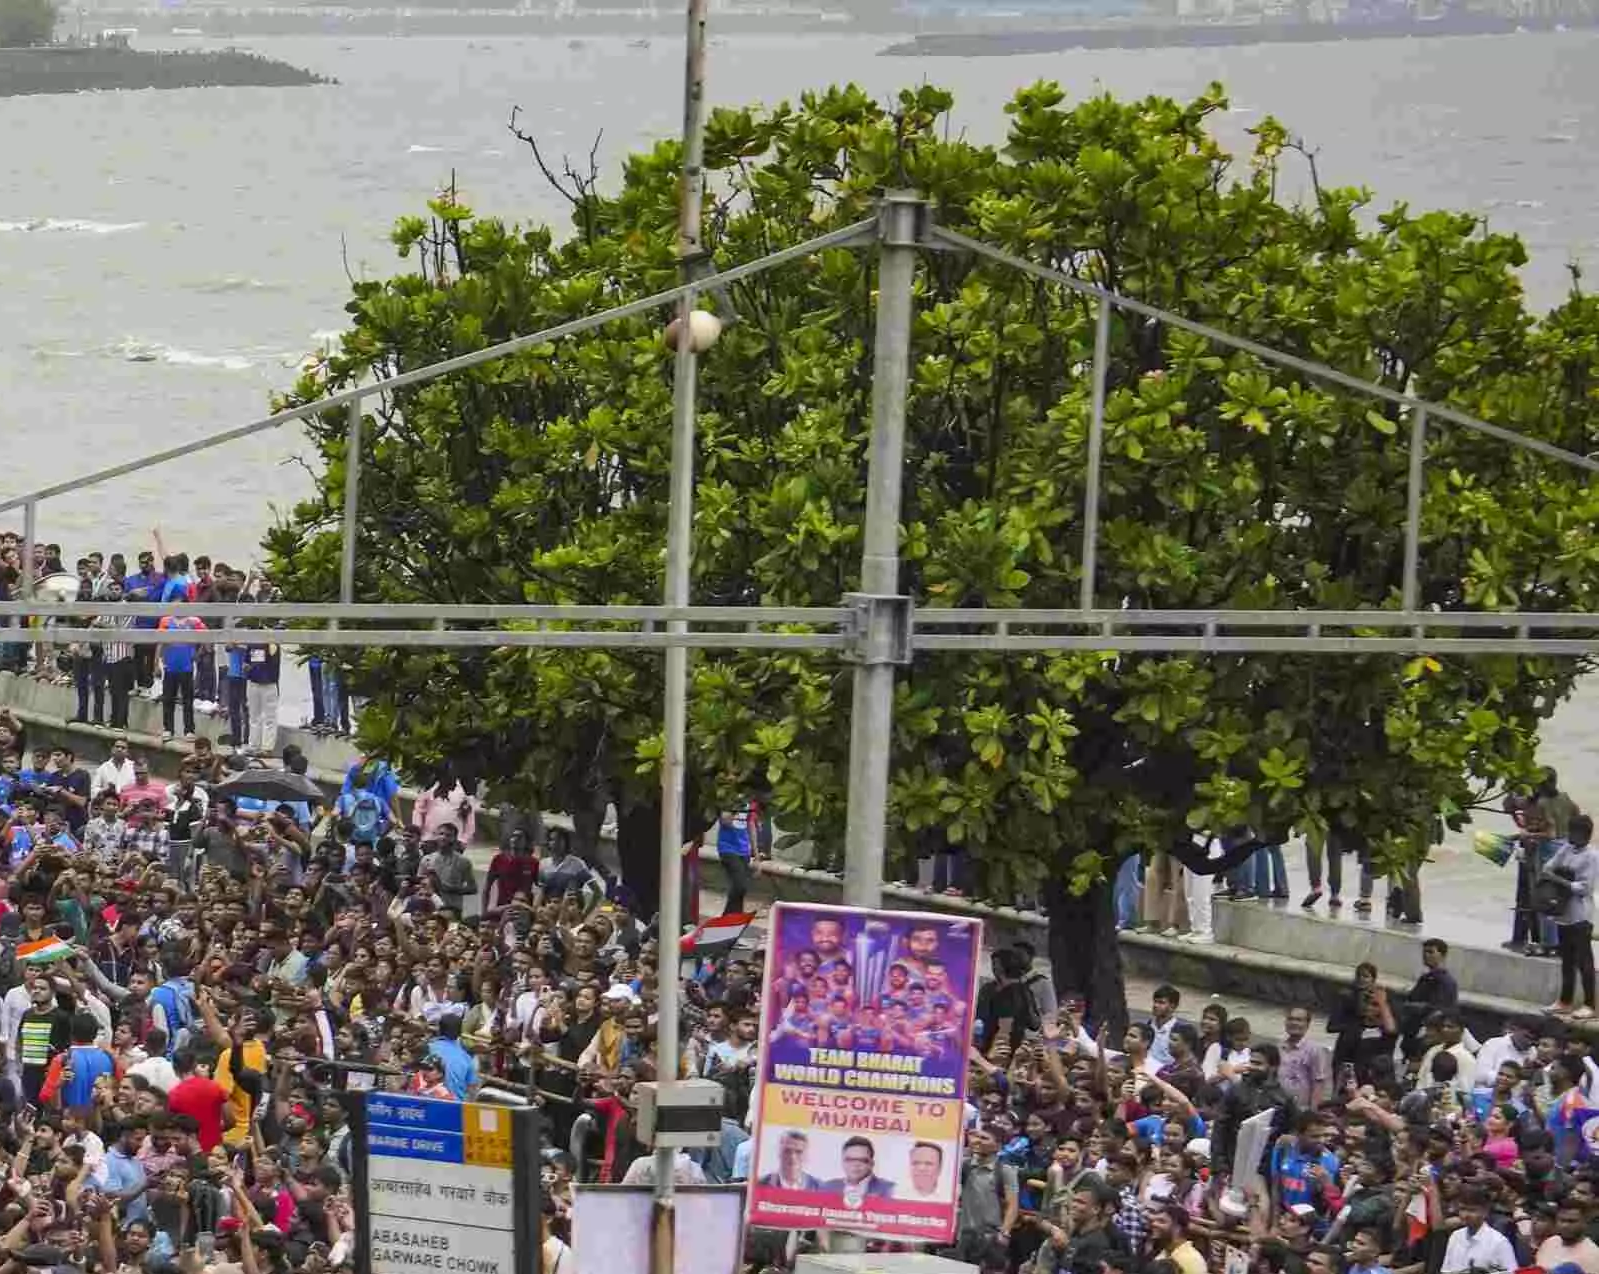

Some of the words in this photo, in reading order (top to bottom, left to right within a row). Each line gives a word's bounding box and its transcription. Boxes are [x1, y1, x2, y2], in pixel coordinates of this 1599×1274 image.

[808, 1047, 854, 1066] TEAM
[857, 1052, 924, 1074] BHARAT
[774, 1063, 842, 1086] WORLD
[844, 1070, 956, 1095] CHAMPIONS
[781, 1089, 907, 1114] WELCOME
[915, 1102, 946, 1118] TO
[811, 1110, 913, 1132] MUMBAI
[372, 1229, 450, 1250] ABASAHEB
[371, 1248, 442, 1269] GARWARE
